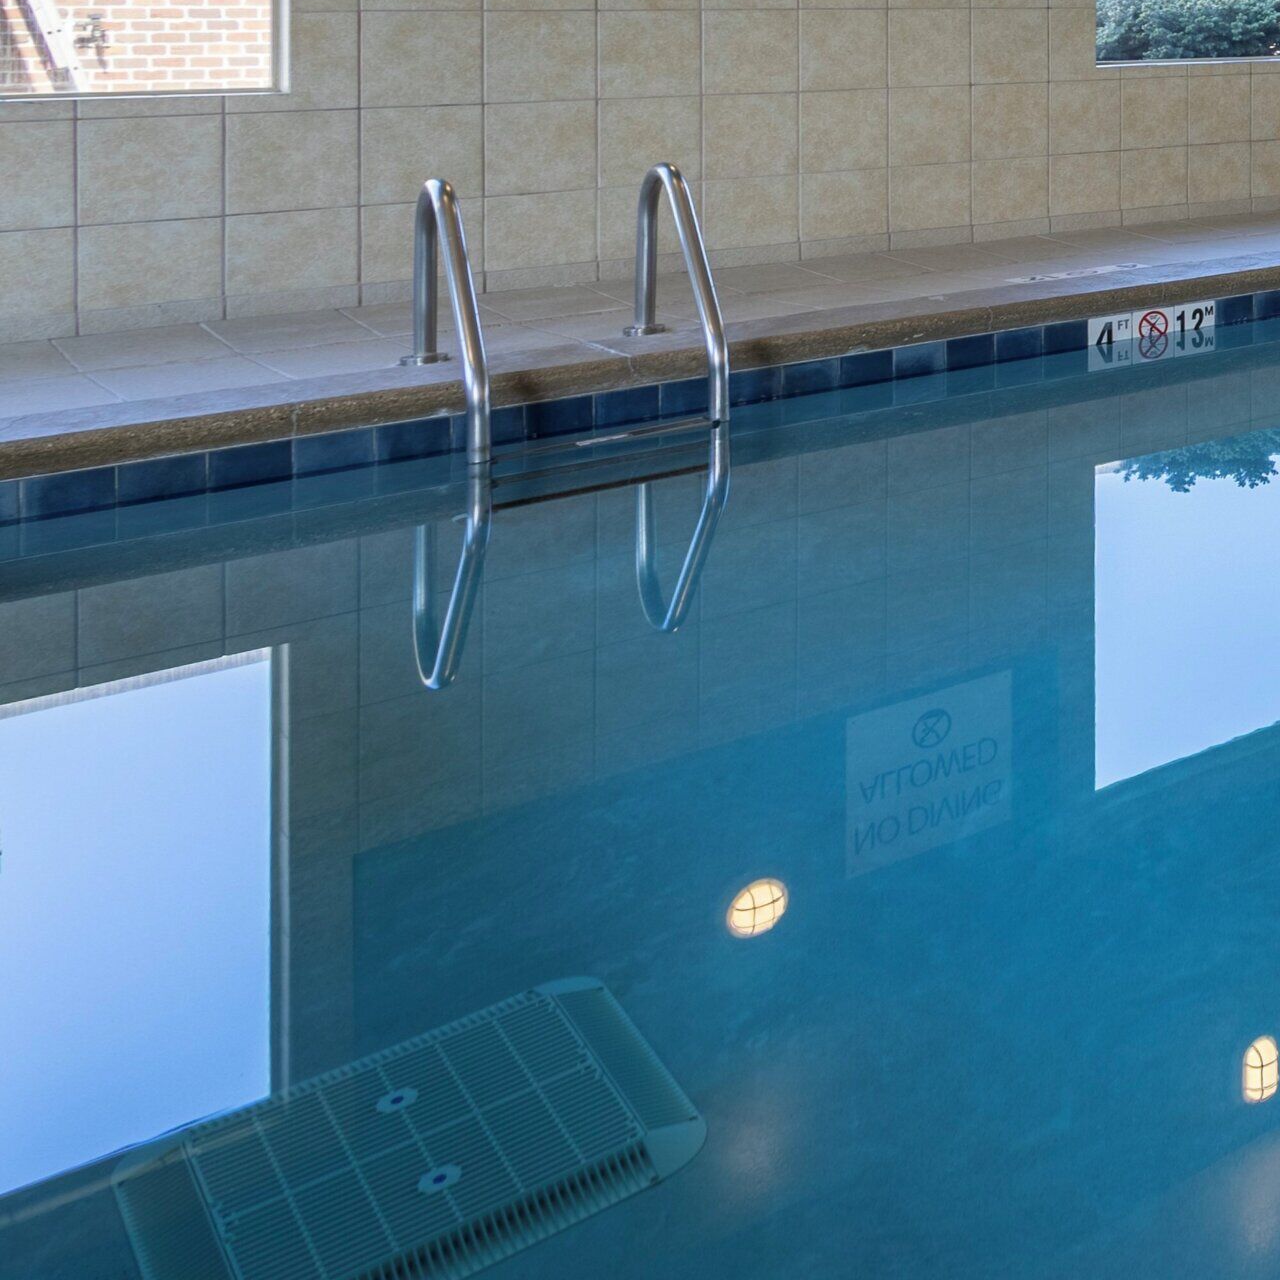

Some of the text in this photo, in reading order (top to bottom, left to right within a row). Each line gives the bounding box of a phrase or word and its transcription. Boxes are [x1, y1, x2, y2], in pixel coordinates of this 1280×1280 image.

[1096, 321, 1115, 345] 4
[1118, 319, 1129, 330] FT
[1205, 306, 1213, 316] M
